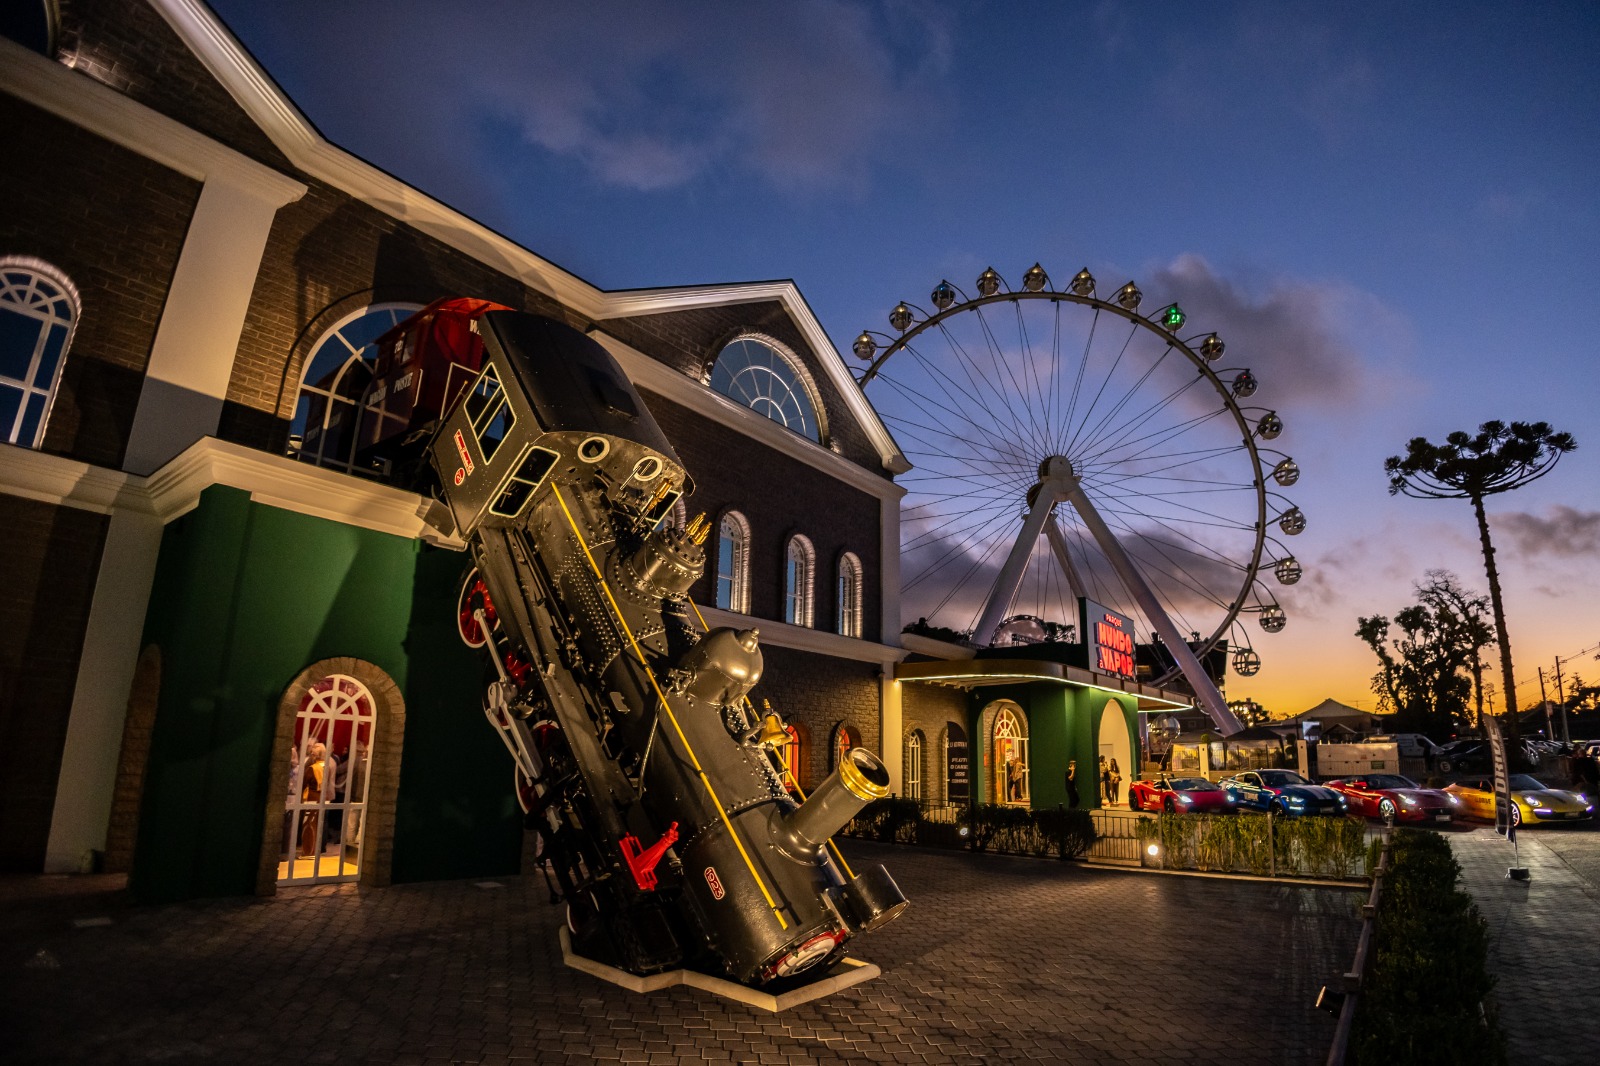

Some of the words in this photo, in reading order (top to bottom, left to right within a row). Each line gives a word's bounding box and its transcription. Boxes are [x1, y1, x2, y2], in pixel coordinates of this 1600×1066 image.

[1105, 613, 1122, 628] PARQUE
[1098, 622, 1132, 654] MUNDO
[1101, 646, 1133, 676] VAPOR
[1489, 726, 1507, 794] DRIVE
[705, 868, 723, 898] 1923
